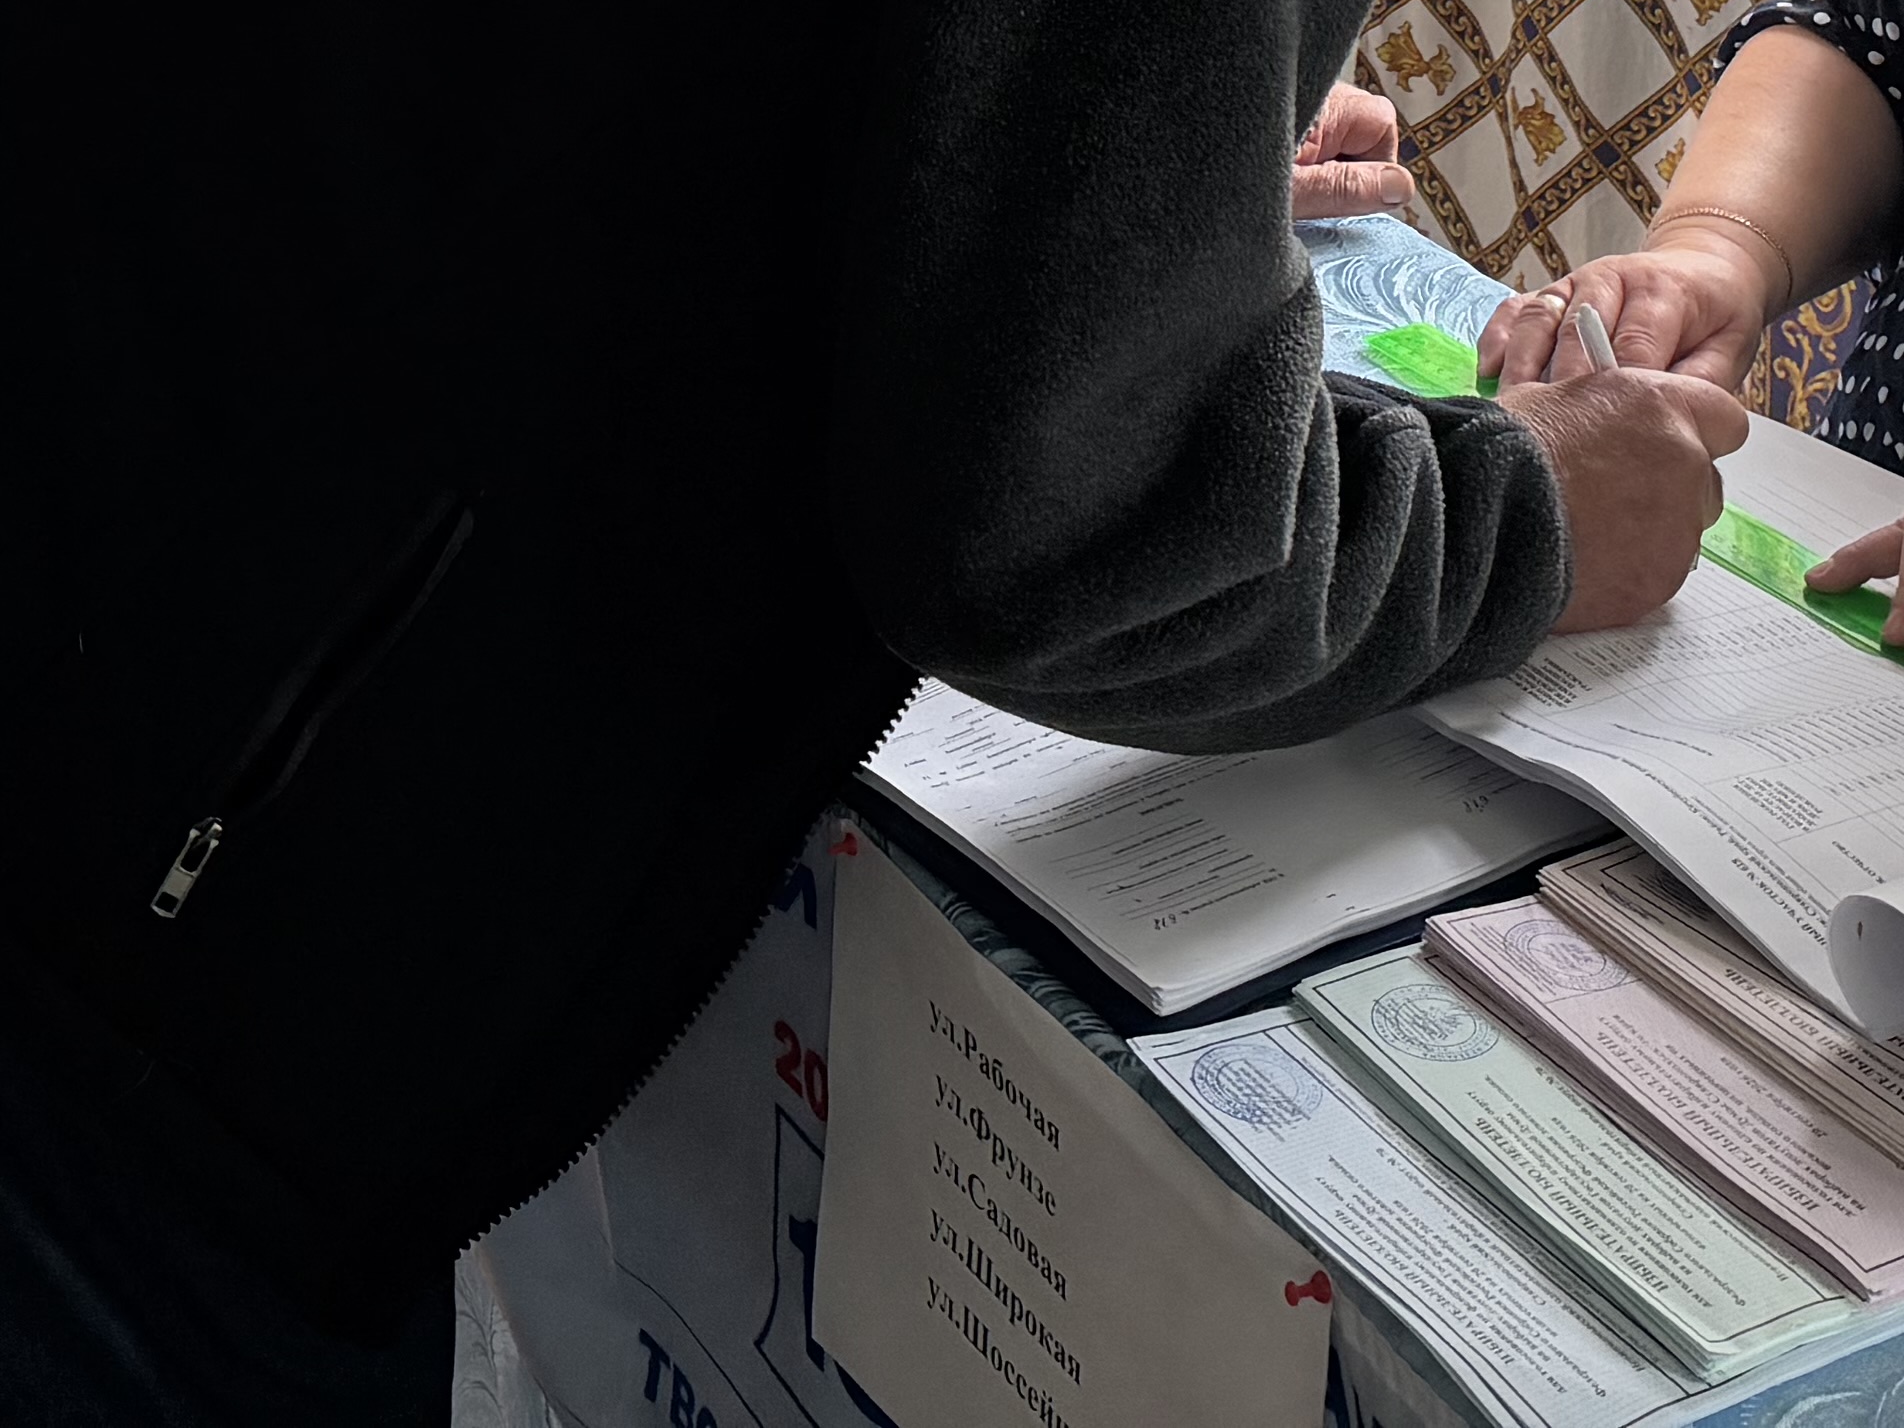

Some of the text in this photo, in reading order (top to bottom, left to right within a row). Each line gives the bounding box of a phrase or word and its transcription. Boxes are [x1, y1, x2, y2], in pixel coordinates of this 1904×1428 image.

[928, 998, 1062, 1152] ул.Рабочая
[1590, 1031, 1687, 1109] БЮЛЛЕТЕНЬ
[1718, 967, 1821, 1036] БЮЛЛЕТЕНЬ
[932, 1137, 1070, 1301] ул.Садовая
[934, 1072, 1058, 1218] ул.Фрунзе
[1470, 1116, 1670, 1291] ИЗБИРАТЕЛЬНЫЙ БЮЛЛЕТЕНЬ
[1681, 1110, 1820, 1211] ИЗБИРАТЕЛЬНЫЙ
[929, 1206, 1082, 1386] ул.Широкая
